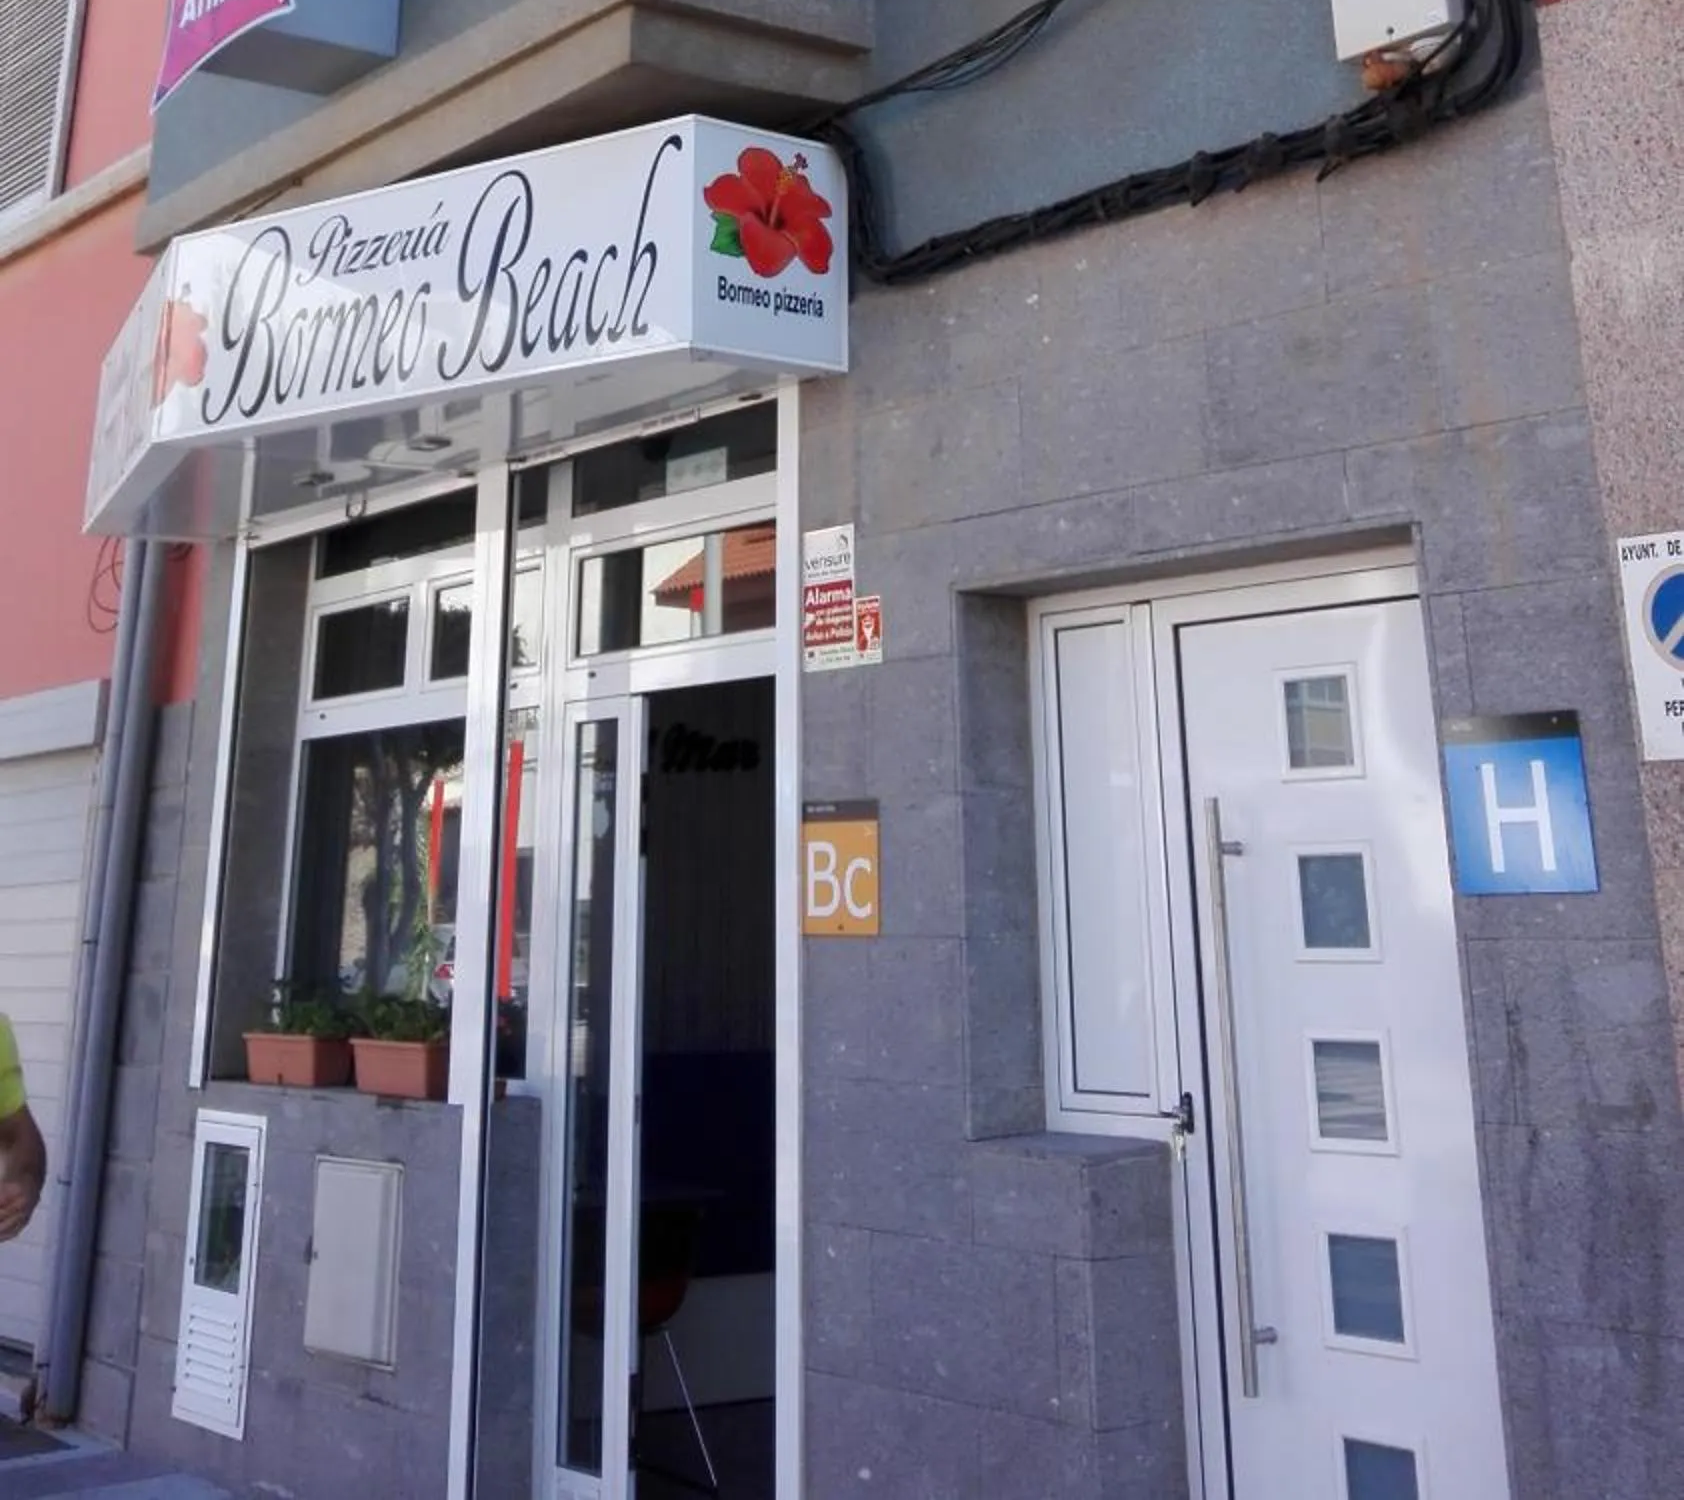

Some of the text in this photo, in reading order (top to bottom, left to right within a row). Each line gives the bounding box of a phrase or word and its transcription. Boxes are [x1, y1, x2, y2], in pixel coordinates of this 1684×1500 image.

[202, 134, 684, 425] Bormeo Beach
[717, 275, 771, 308] Bormeo
[1667, 539, 1683, 557] DE
[1480, 759, 1557, 874] H
